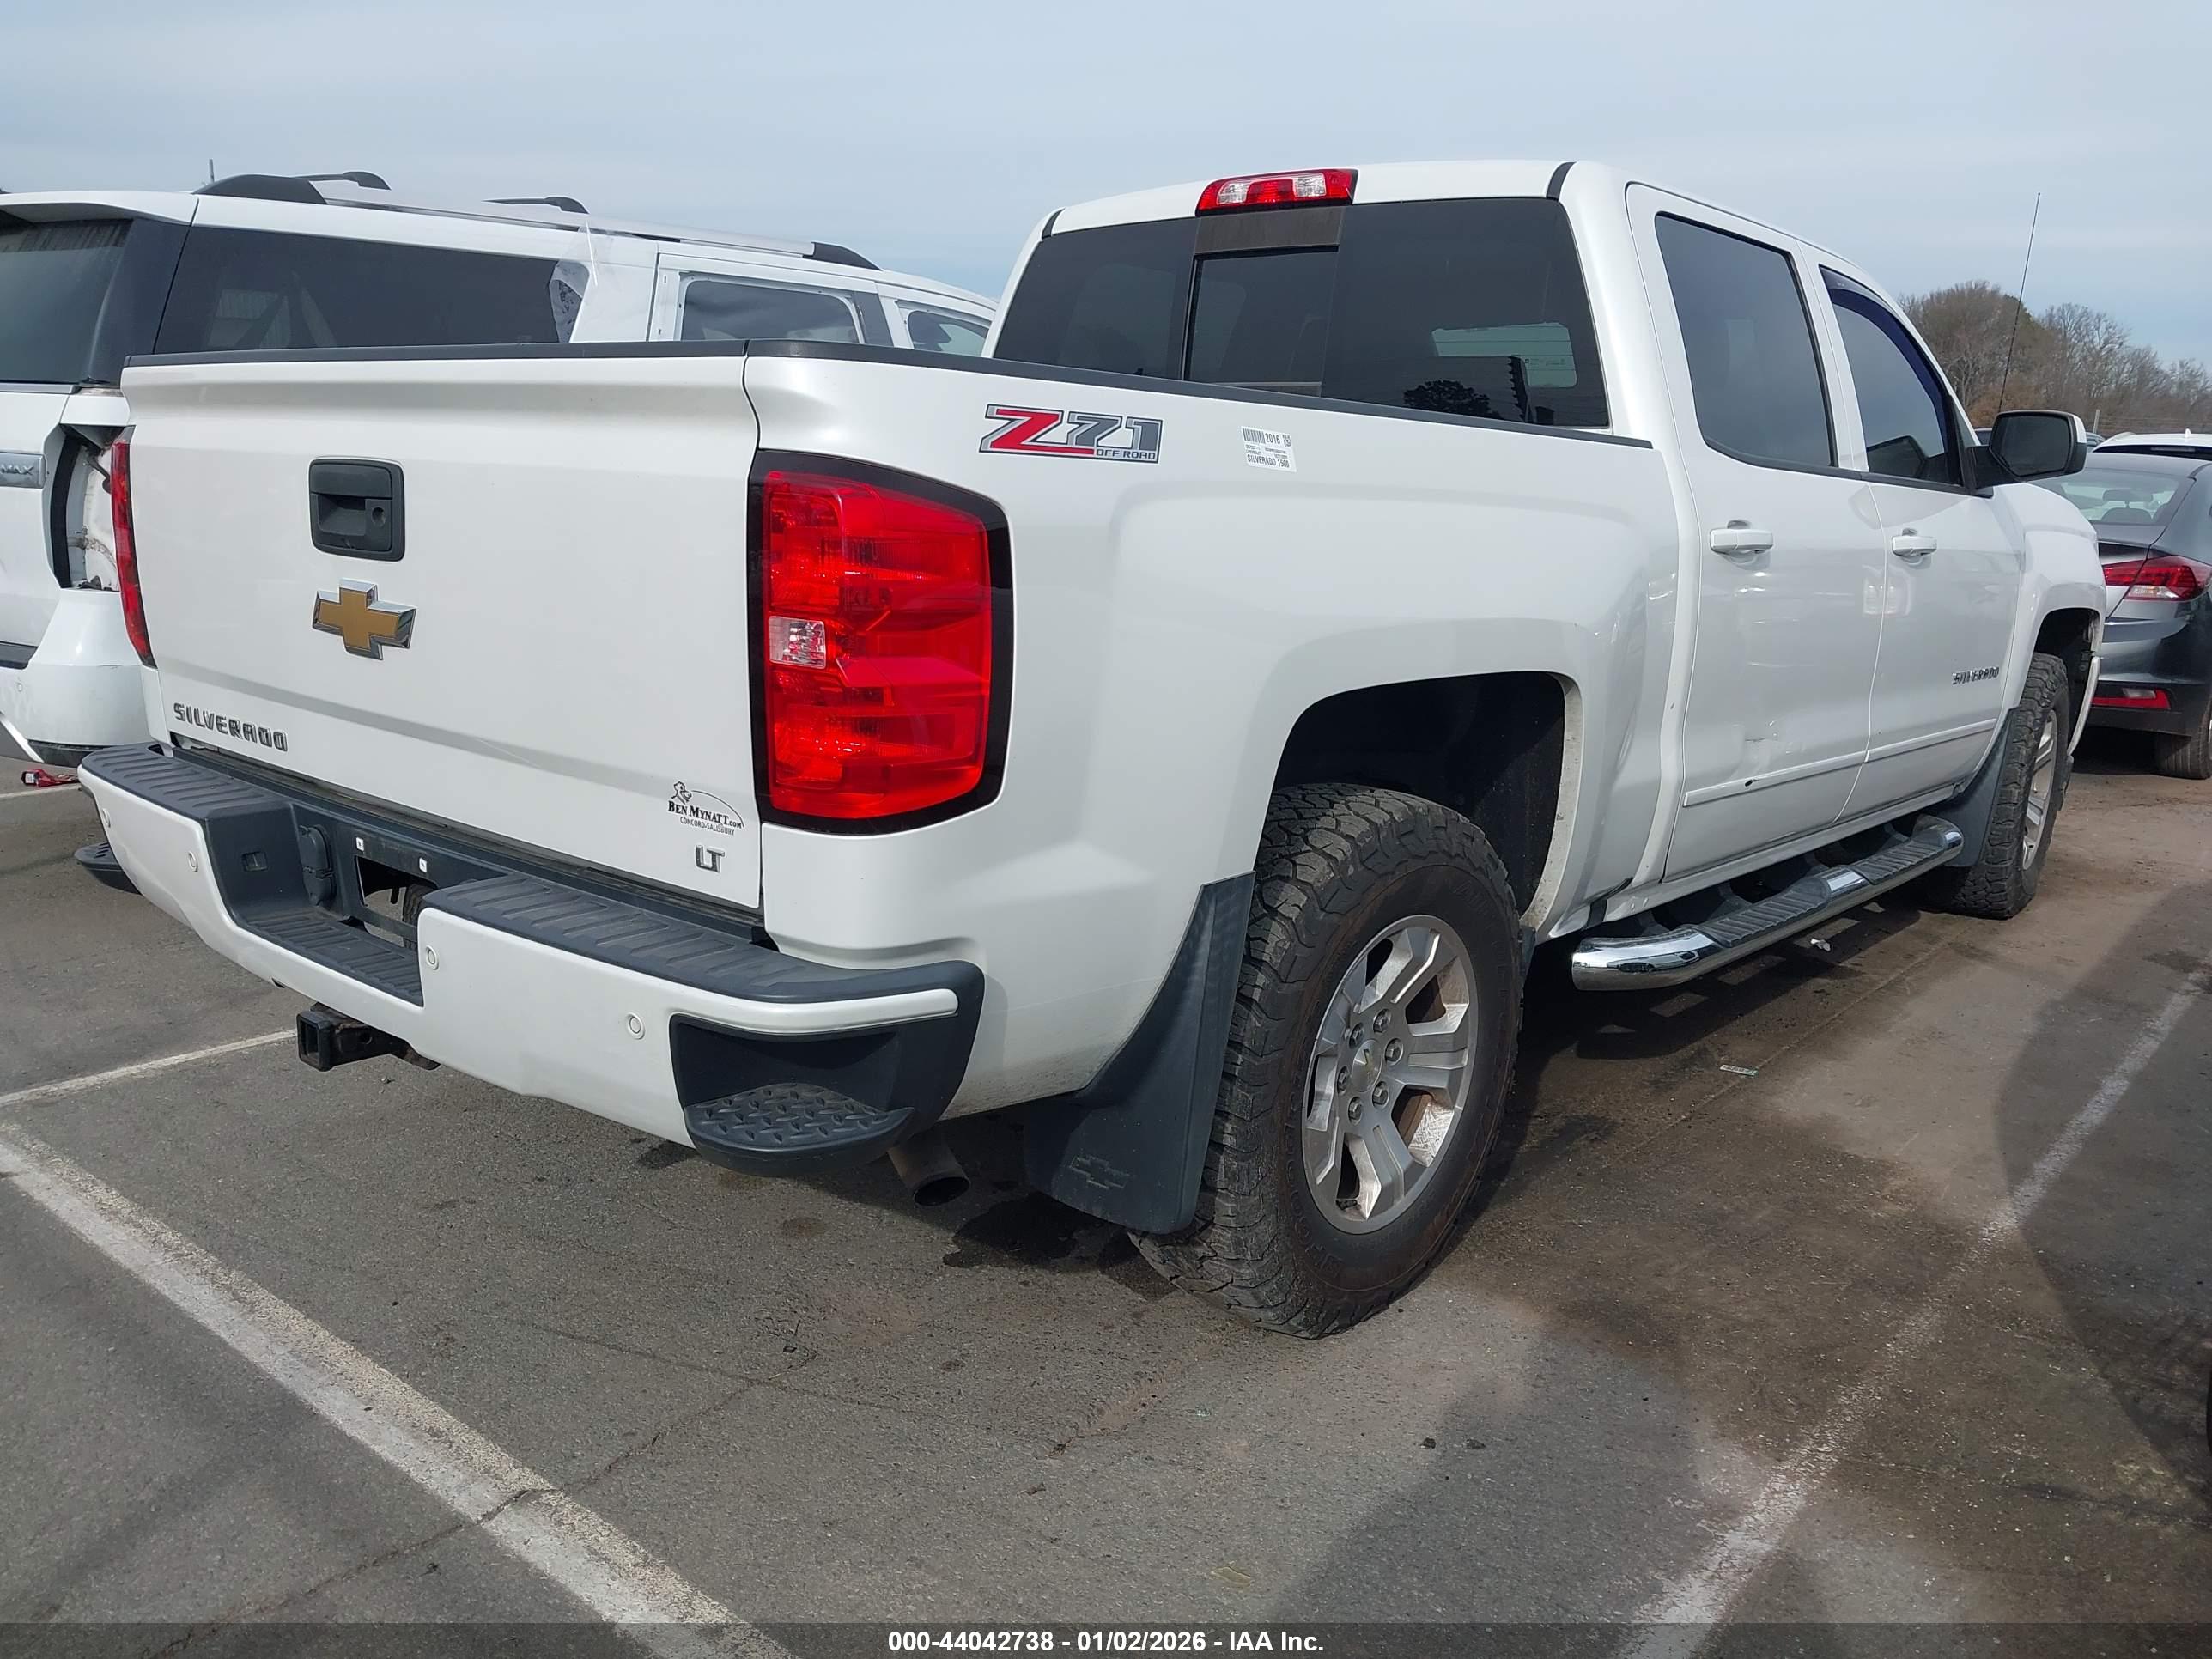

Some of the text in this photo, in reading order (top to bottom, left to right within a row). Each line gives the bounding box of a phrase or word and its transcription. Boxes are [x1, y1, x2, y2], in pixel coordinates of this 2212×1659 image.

[979, 404, 1164, 454] Z71
[1265, 433, 1281, 445] 2016
[1096, 448, 1157, 461] OFF ROAD
[1247, 454, 1277, 466] SILVERADO
[173, 702, 289, 752] SILVERADO
[695, 844, 725, 873] LT
